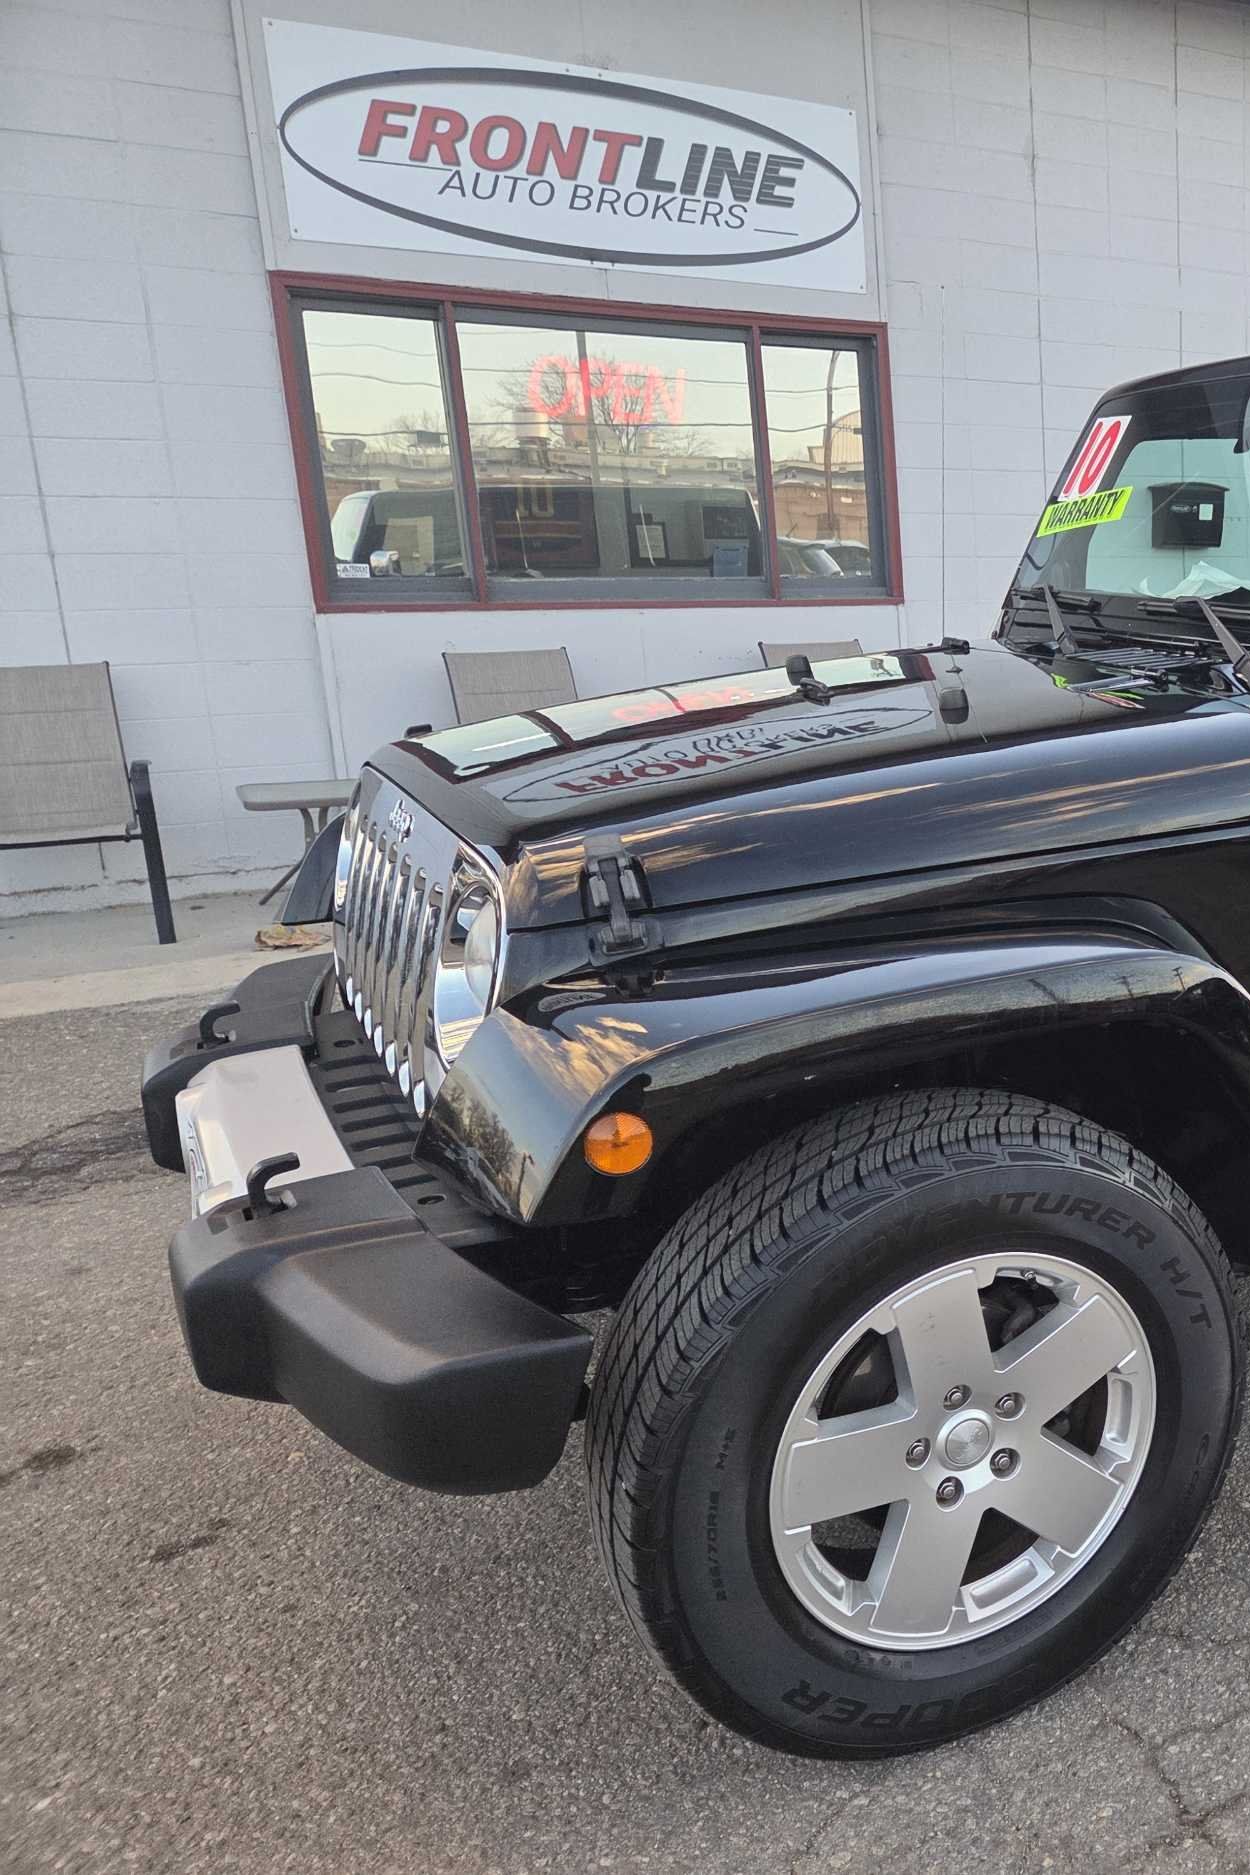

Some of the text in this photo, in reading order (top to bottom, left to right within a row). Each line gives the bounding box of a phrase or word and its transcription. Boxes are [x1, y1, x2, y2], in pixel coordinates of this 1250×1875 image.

[357, 98, 805, 209] FRONTLINE
[437, 170, 748, 230] AUTO BROKERS
[528, 355, 686, 425] OPEN
[1062, 420, 1122, 496] 10
[1045, 489, 1125, 530] WARRANTY
[1160, 1256, 1213, 1329] H/T
